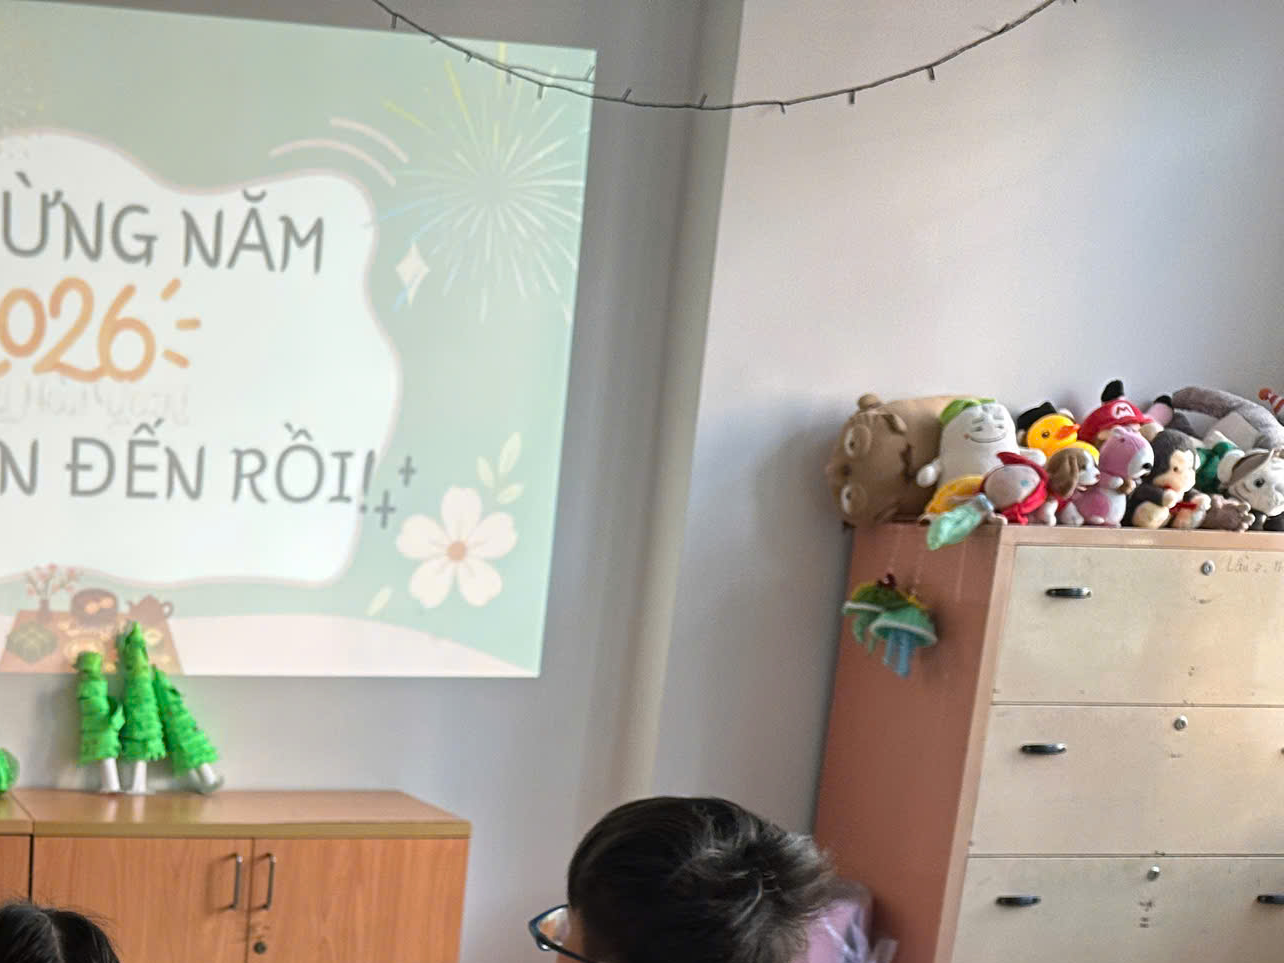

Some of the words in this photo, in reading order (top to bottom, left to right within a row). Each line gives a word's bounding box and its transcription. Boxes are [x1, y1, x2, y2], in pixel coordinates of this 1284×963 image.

[181, 188, 325, 274] NĂM
[64, 418, 206, 501] ĐẾN
[231, 422, 376, 514] RỒI!
